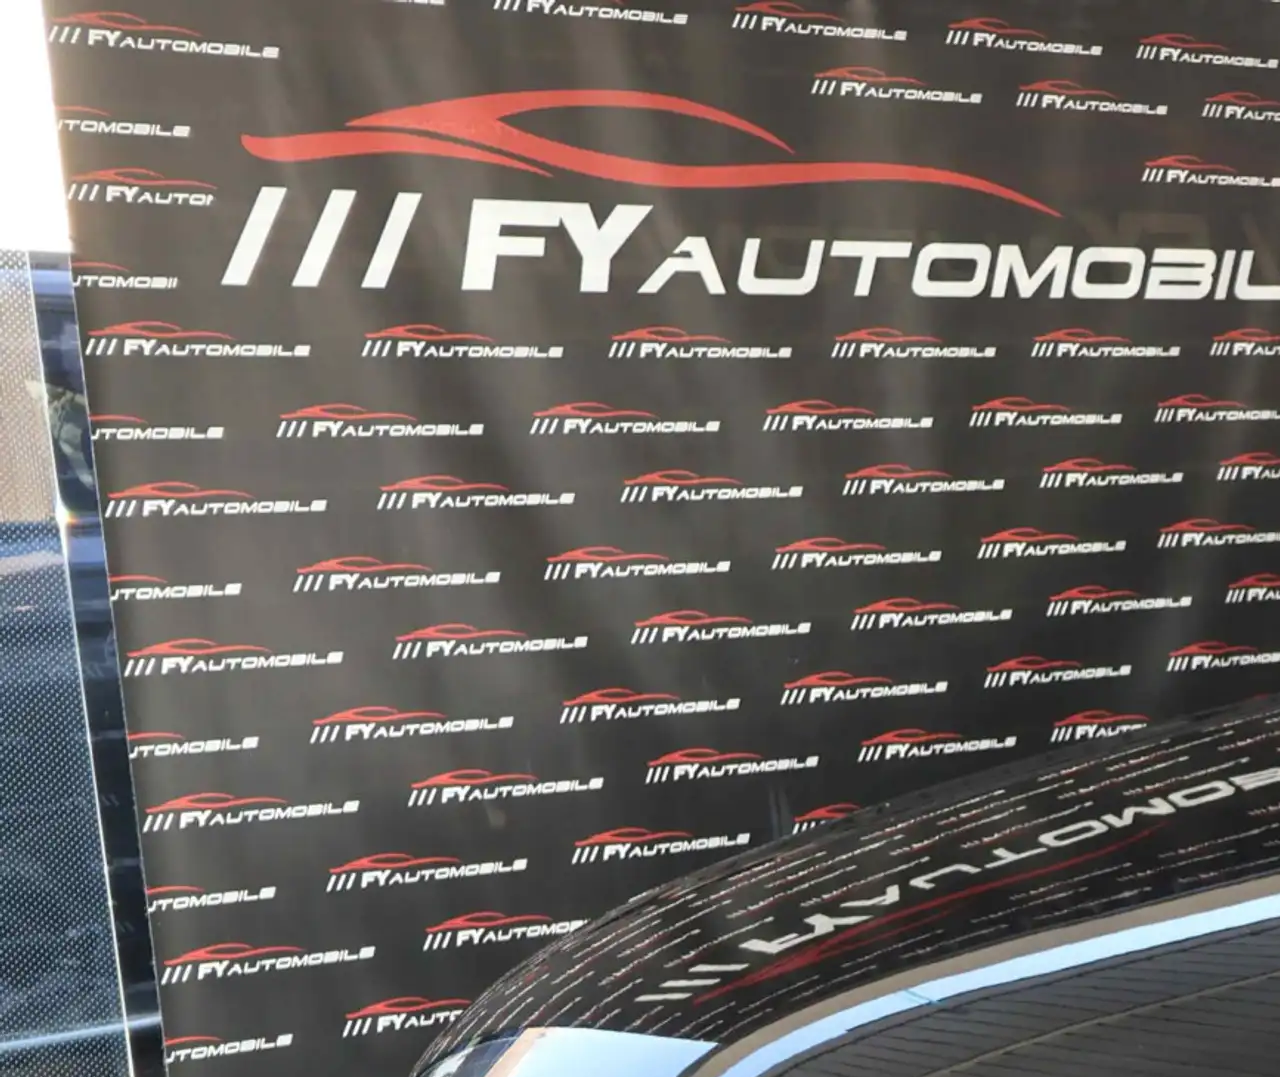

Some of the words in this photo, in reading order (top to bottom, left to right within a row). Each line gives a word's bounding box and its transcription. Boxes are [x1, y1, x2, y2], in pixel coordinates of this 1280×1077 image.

[527, 0, 688, 25] FYAUTOMOBILE
[761, 16, 907, 41] FYAUTOMOBILE
[88, 29, 279, 59] FYAUTOMOBILE
[972, 32, 1103, 55] FYAUTOMOBILE
[1159, 46, 1279, 68] FYAUTOMOBILE
[840, 82, 983, 104] FYAUTOMOBILE
[1041, 94, 1168, 115] FYAUTOMOBILE
[123, 339, 311, 357] FYAUTOMOBILE
[396, 341, 564, 358] FYAUTOMOBILE
[640, 342, 792, 358] FYAUTOMOBILE
[859, 343, 996, 358] FYAUTOMOBILE
[1056, 343, 1181, 357] FYAUTOMOBILE
[312, 421, 484, 437] FYAUTOMOBILE
[563, 418, 720, 434] FYAUTOMOBILE
[792, 415, 933, 431] FYAUTOMOBILE
[994, 411, 1123, 426] FYAUTOMOBILE
[869, 479, 1005, 495] FYAUTOMOBILE
[1065, 466, 1184, 487] FYAUTOMOBILE
[412, 492, 575, 509] FYAUTOMOBILE
[652, 485, 803, 502] FYAUTOMOBILE
[142, 499, 327, 517] FYAUTOMOBILE
[801, 549, 942, 568] FYAUTOMOBILE
[1003, 540, 1126, 558] FYAUTOMOBILE
[574, 560, 731, 579] FYAUTOMOBILE
[328, 571, 501, 591] FYAUTOMOBILE
[1070, 595, 1192, 615] FYAUTOMOBILE
[879, 609, 1013, 629] FYAUTOMOBILE
[662, 621, 811, 643] FYAUTOMOBILE
[426, 636, 588, 658] FYAUTOMOBILE
[161, 650, 344, 675] FYAUTOMOBILE
[1009, 664, 1132, 686] FYAUTOMOBILE
[809, 681, 948, 703] FYAUTOMOBILE
[588, 698, 741, 722] FYAUTOMOBILE
[345, 714, 514, 741] FYAUTOMOBILE
[884, 736, 1017, 760] FYAUTOMOBILE
[672, 755, 819, 781] FYAUTOMOBILE
[441, 777, 604, 804] FYAUTOMOBILE
[179, 801, 360, 829] FYAUTOMOBILE
[603, 832, 750, 861] FYAUTOMOBILE
[361, 858, 528, 888] FYAUTOMOBILE
[198, 945, 376, 980] FYAUTOMOBILE
